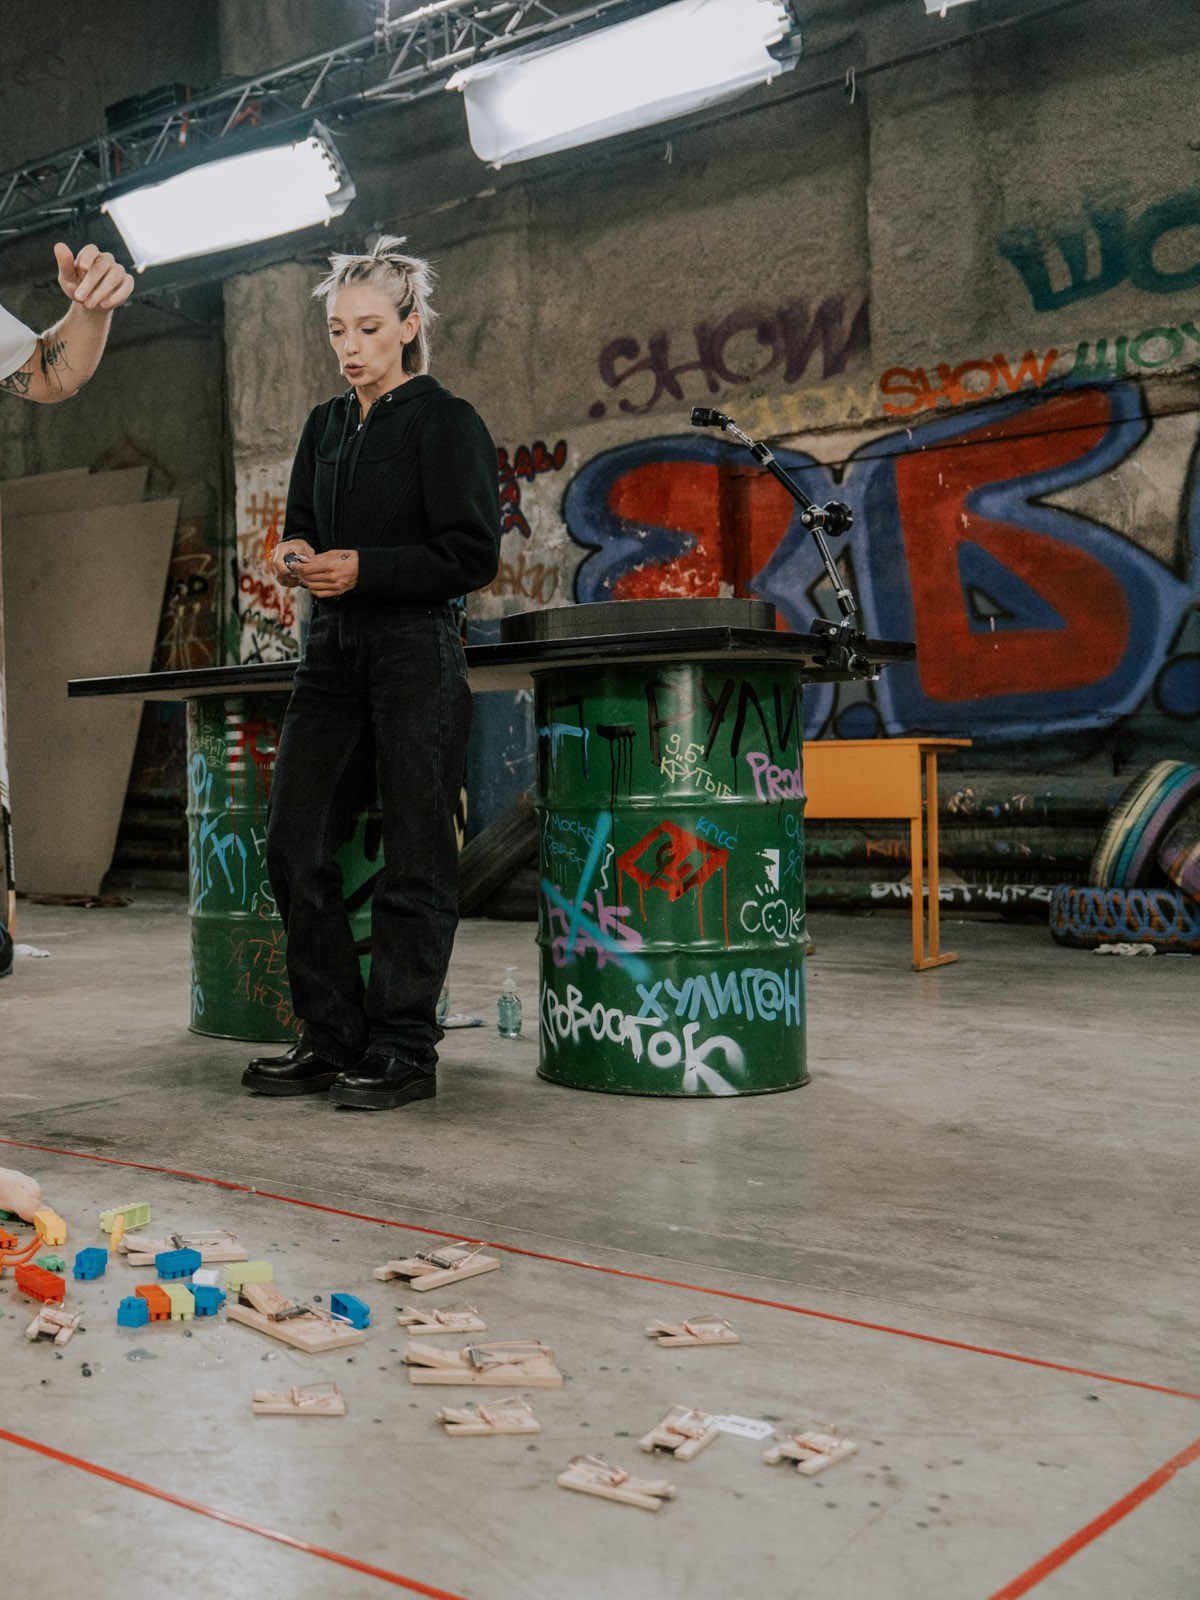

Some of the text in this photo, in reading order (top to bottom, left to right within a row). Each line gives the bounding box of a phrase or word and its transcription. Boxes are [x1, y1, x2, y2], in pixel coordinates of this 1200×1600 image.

[878, 349, 1058, 415] SHOW
[661, 757, 732, 798] КРУТЫЕ
[695, 816, 738, 849] КПСС
[635, 967, 800, 1026] ХУЛИГ@Н
[540, 980, 745, 1096] КРОВОСТОК
